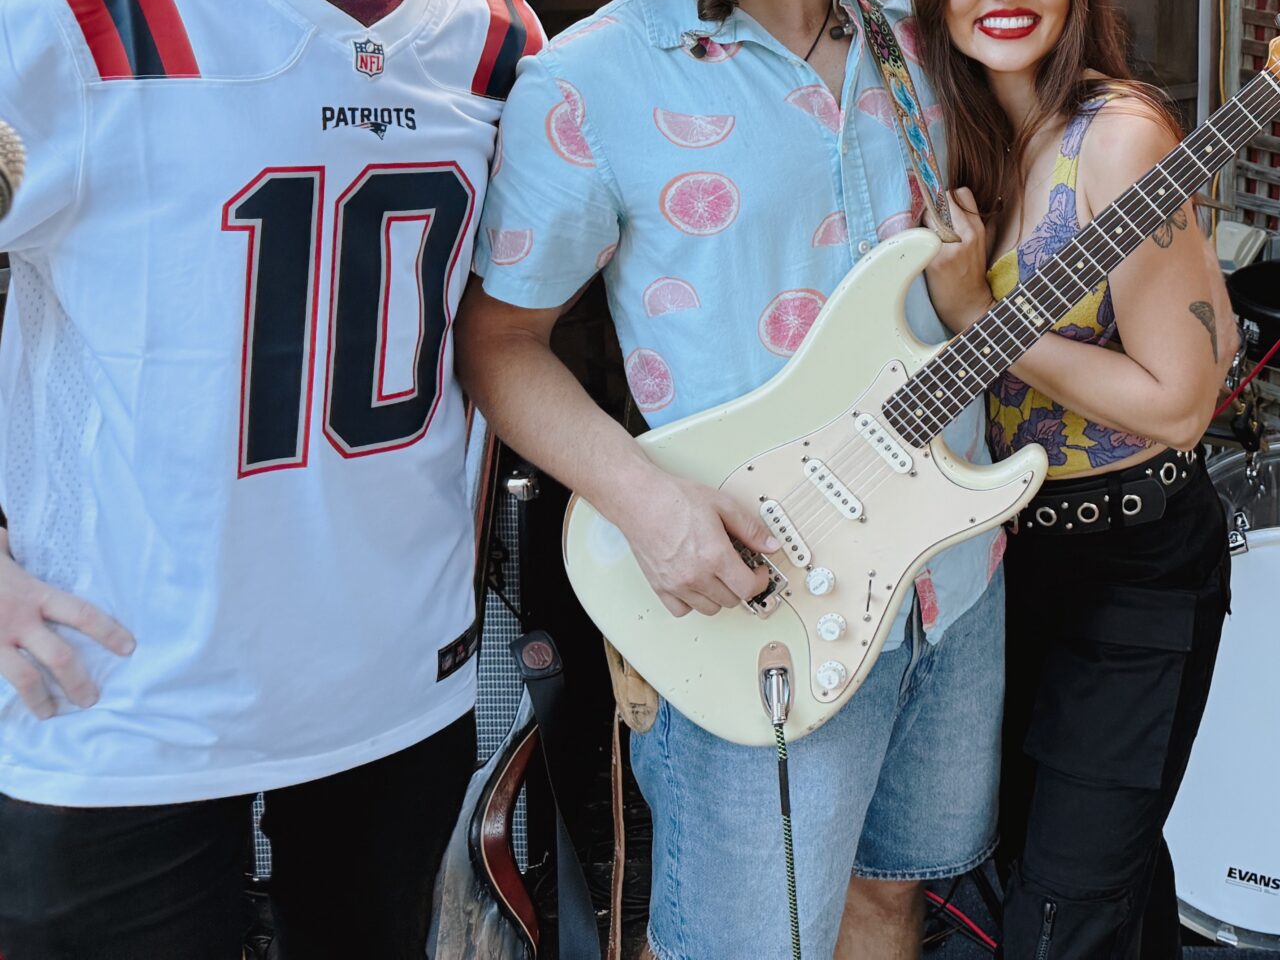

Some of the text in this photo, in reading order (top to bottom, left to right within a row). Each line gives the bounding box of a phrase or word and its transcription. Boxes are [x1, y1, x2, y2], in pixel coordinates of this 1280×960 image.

[358, 54, 384, 73] NFL
[321, 106, 417, 131] PATRIOTS
[221, 159, 476, 479] 10
